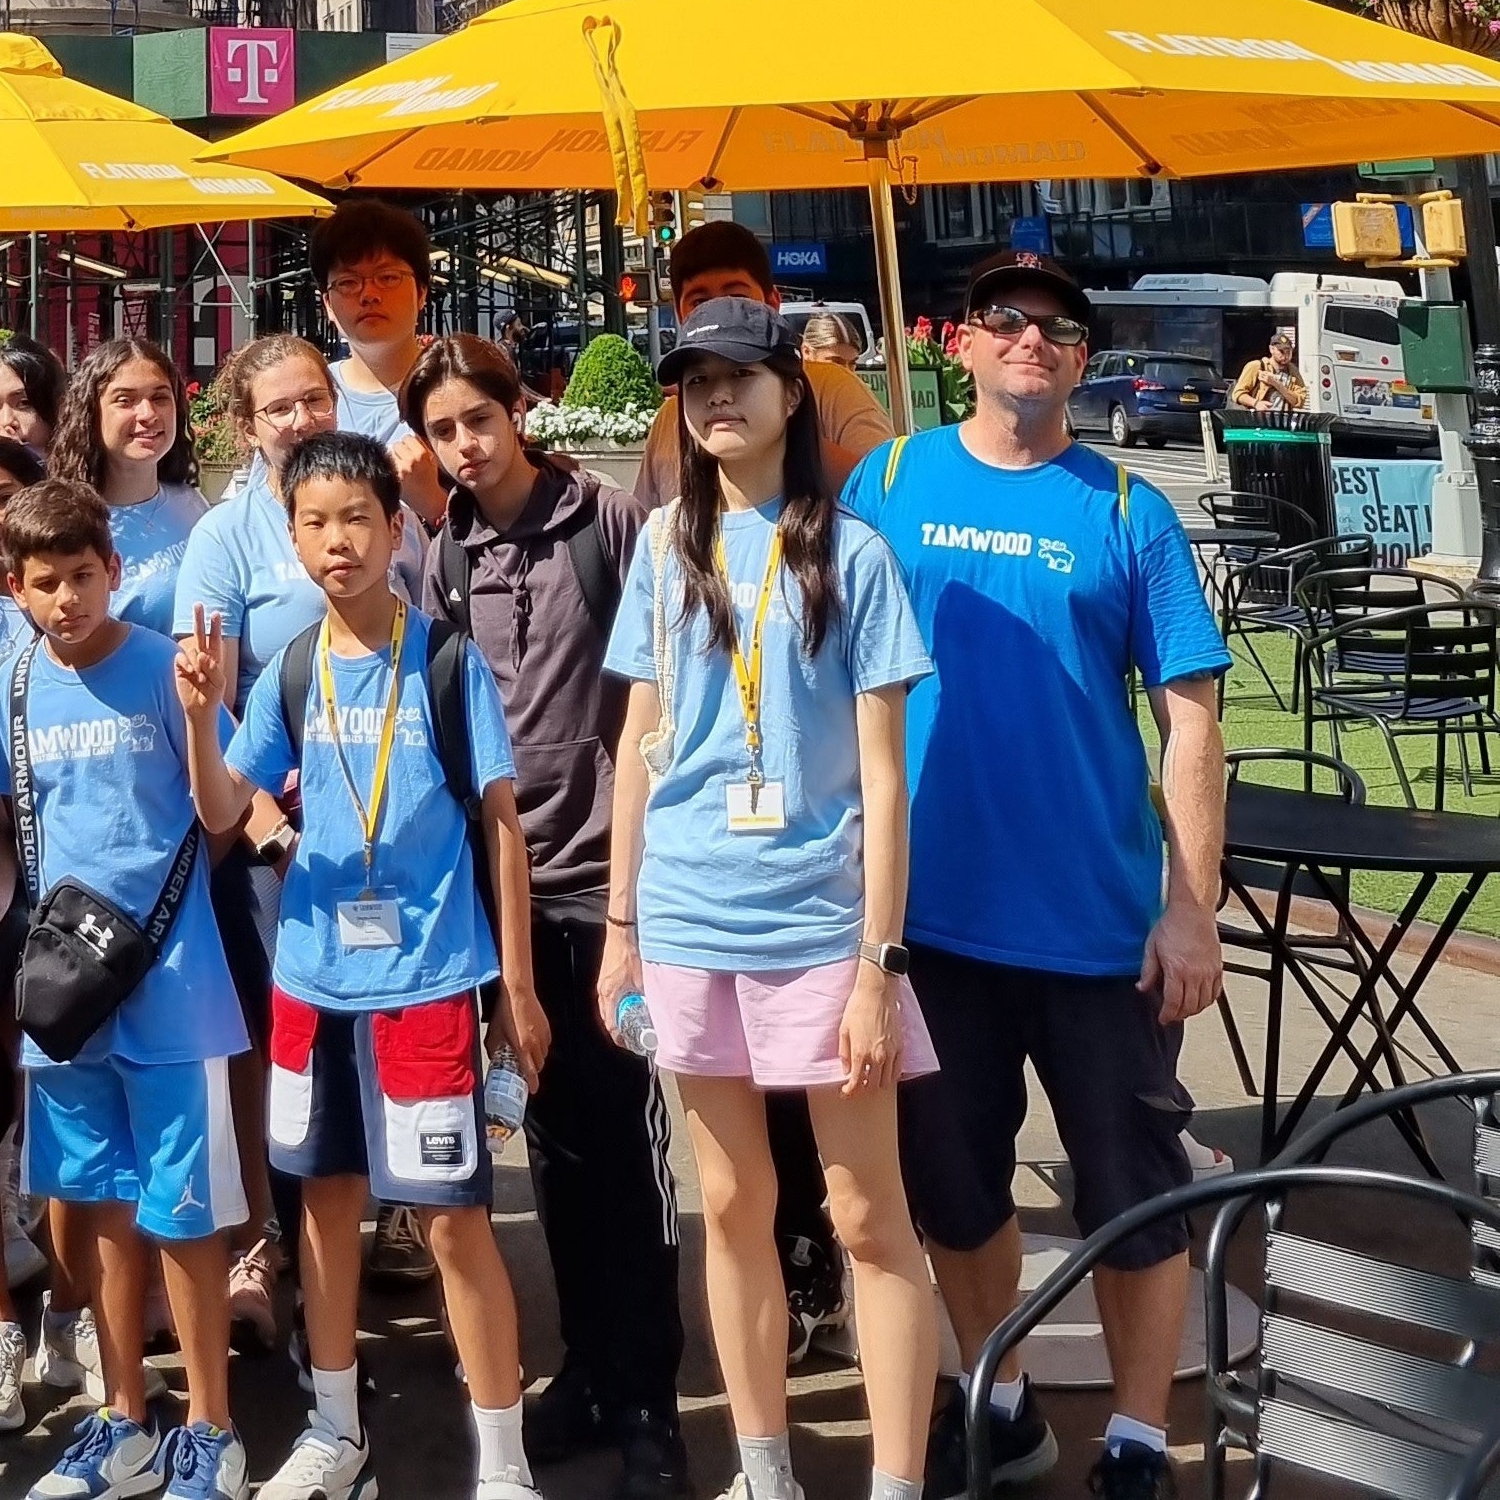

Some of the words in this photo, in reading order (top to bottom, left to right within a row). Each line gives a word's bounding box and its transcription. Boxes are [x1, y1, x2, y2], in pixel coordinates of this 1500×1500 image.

[1105, 30, 1322, 61] FLATIRON
[80, 162, 188, 179] FLATIRON
[777, 251, 821, 266] HOKA
[1361, 504, 1419, 533] SEAT
[921, 522, 1032, 557] TAMWOOD
[14, 642, 36, 697] UNDE
[27, 718, 117, 756] AMWOOD
[14, 714, 32, 809] ARMOUR
[19, 813, 38, 892] UNDER
[166, 834, 197, 903] UNDER
